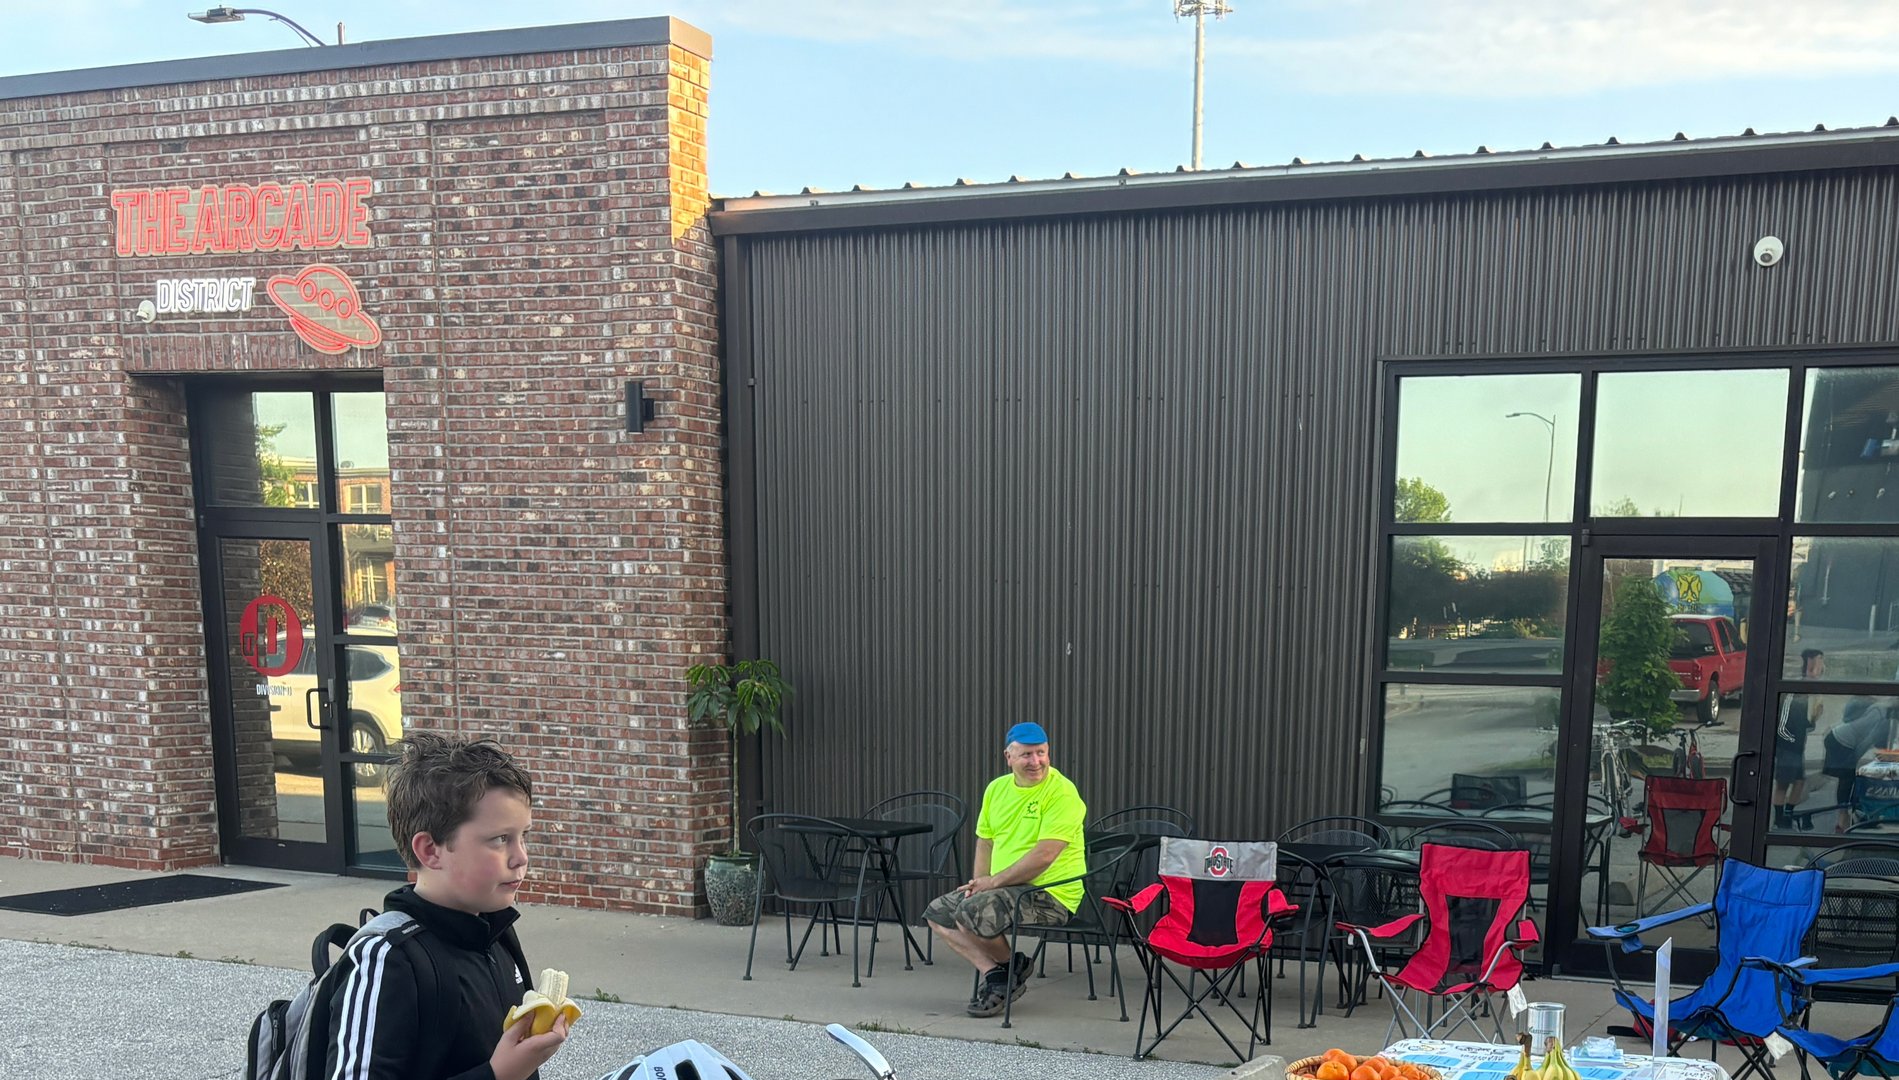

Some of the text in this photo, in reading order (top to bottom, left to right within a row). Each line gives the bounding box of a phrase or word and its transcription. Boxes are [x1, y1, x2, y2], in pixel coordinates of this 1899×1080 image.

[112, 178, 374, 257] THE ARCADE
[156, 277, 256, 313] DISTRICT
